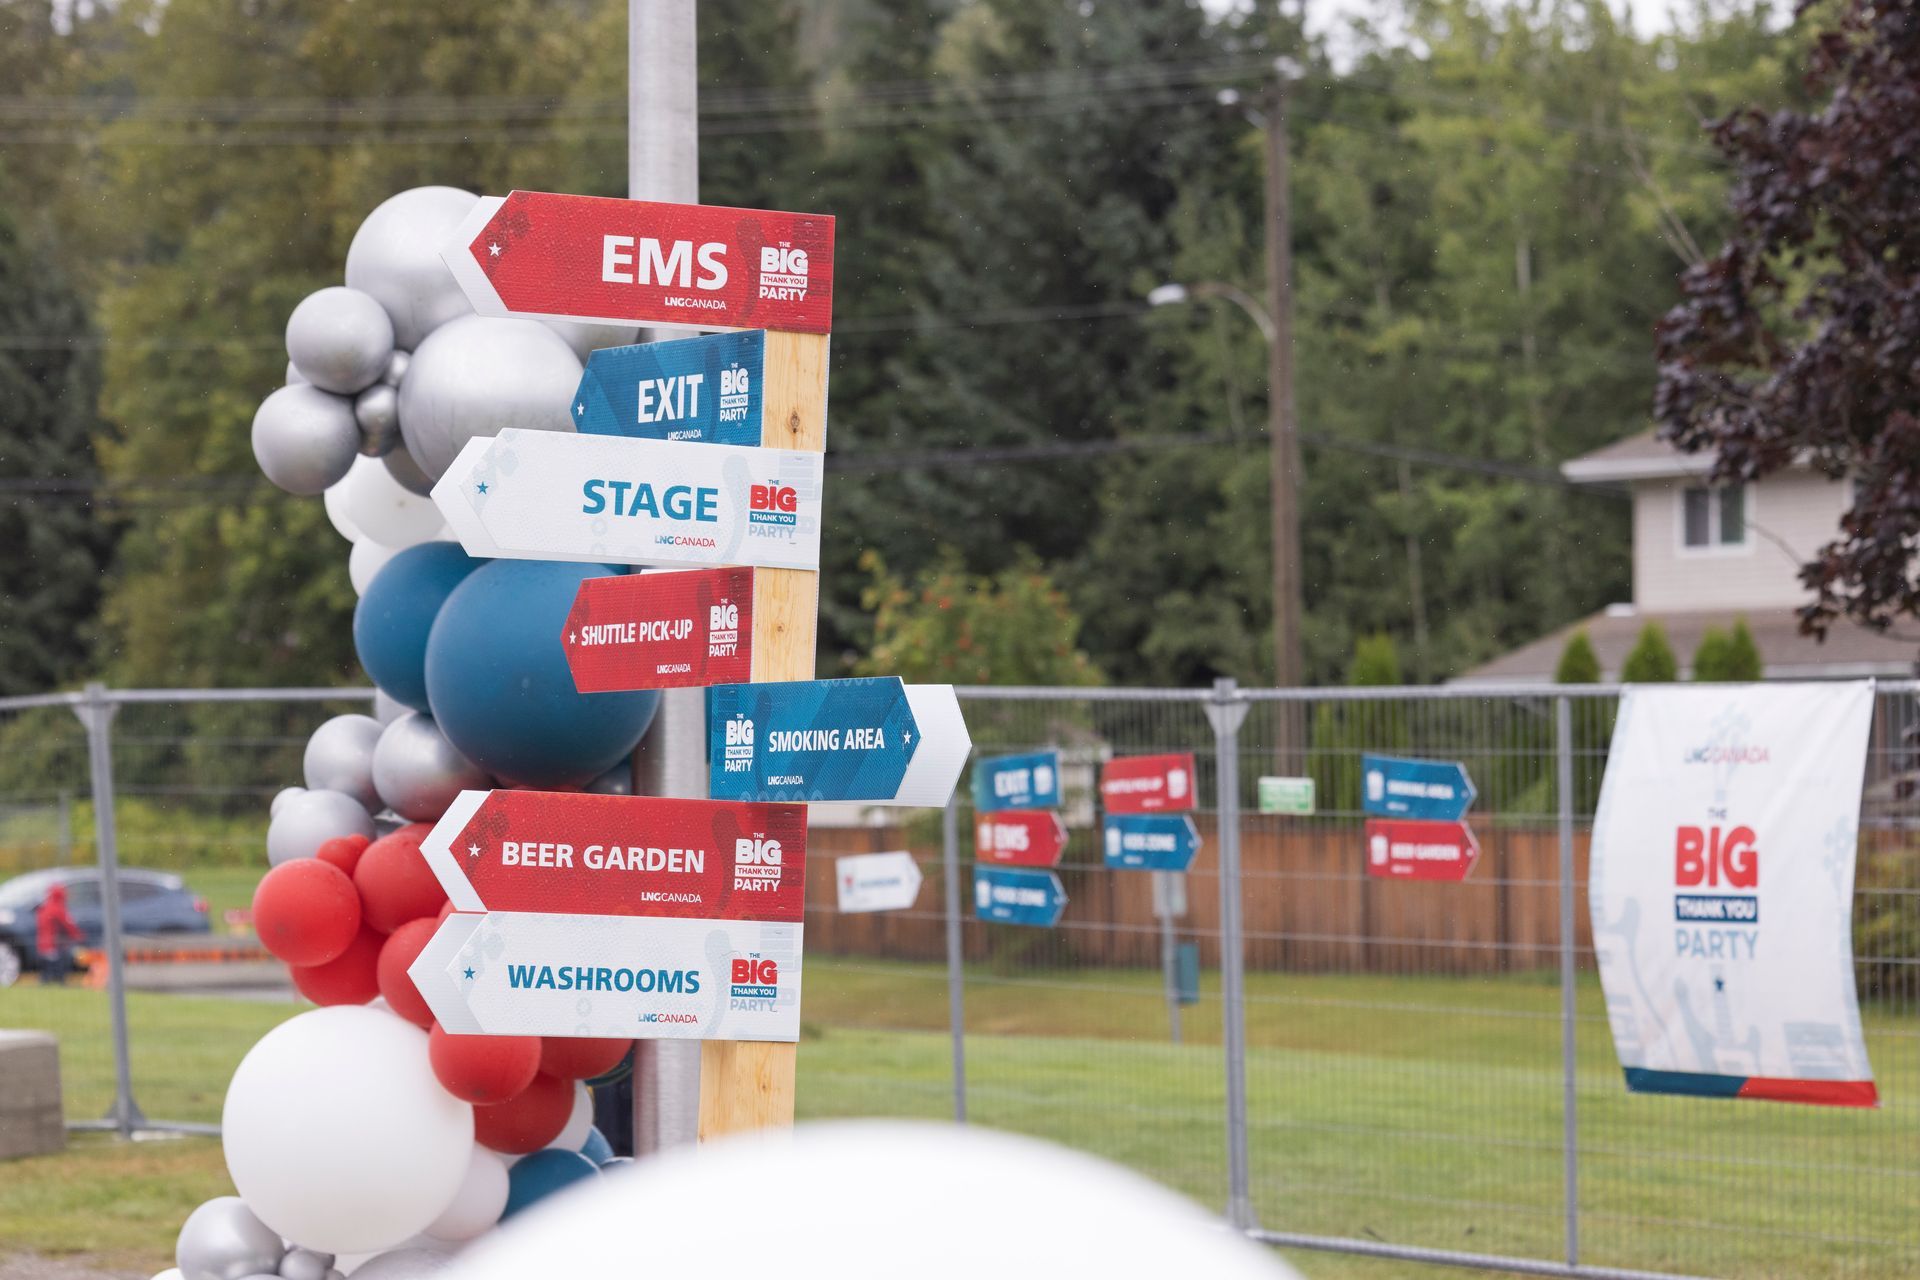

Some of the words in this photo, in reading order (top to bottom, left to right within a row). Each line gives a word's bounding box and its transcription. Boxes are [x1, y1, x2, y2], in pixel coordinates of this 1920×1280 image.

[602, 234, 728, 290] EMS
[760, 246, 808, 274] BIG
[763, 276, 788, 284] THANK
[789, 276, 805, 286] YOU
[760, 286, 807, 301] PARTY
[664, 296, 726, 310] LNGCANADA
[720, 368, 748, 395] BIG
[638, 374, 704, 424] EXIT
[722, 398, 737, 406] THANK
[720, 408, 748, 422] PARTY
[582, 479, 718, 522] STAGE
[750, 484, 797, 512] BIG
[752, 513, 778, 522] THANK
[778, 514, 794, 523] YOU
[748, 524, 796, 539] PARTY
[654, 535, 716, 548] LNGCANADA
[710, 604, 738, 630] BIG
[581, 622, 636, 646] SHUTTLE
[639, 619, 693, 642] PICK-UP
[712, 634, 726, 642] THANK
[708, 644, 737, 658] PARTY
[726, 719, 754, 746] BIG
[768, 730, 839, 752] SMOKING
[844, 728, 885, 750] AREA
[742, 748, 752, 756] YOU
[724, 759, 752, 772] PARTY
[768, 775, 804, 786] LNGCANADA
[502, 841, 574, 868] BEER
[583, 845, 704, 874] GARDEN
[735, 838, 782, 866] BIG
[1675, 825, 1758, 888] BIG
[737, 867, 762, 876] THANK
[762, 868, 779, 876] YOU
[734, 879, 780, 892] PARTY
[640, 891, 702, 904] LNGCANADA
[1678, 898, 1722, 918] THANK
[1722, 898, 1756, 919] YOU
[1676, 929, 1758, 960] PARTY
[507, 964, 700, 994] WASHROOMS
[731, 958, 778, 985] BIG
[733, 988, 757, 996] THANK
[758, 988, 775, 997] YOU
[730, 1000, 776, 1012] PARTY
[638, 1012, 698, 1024] LNGCANADA
